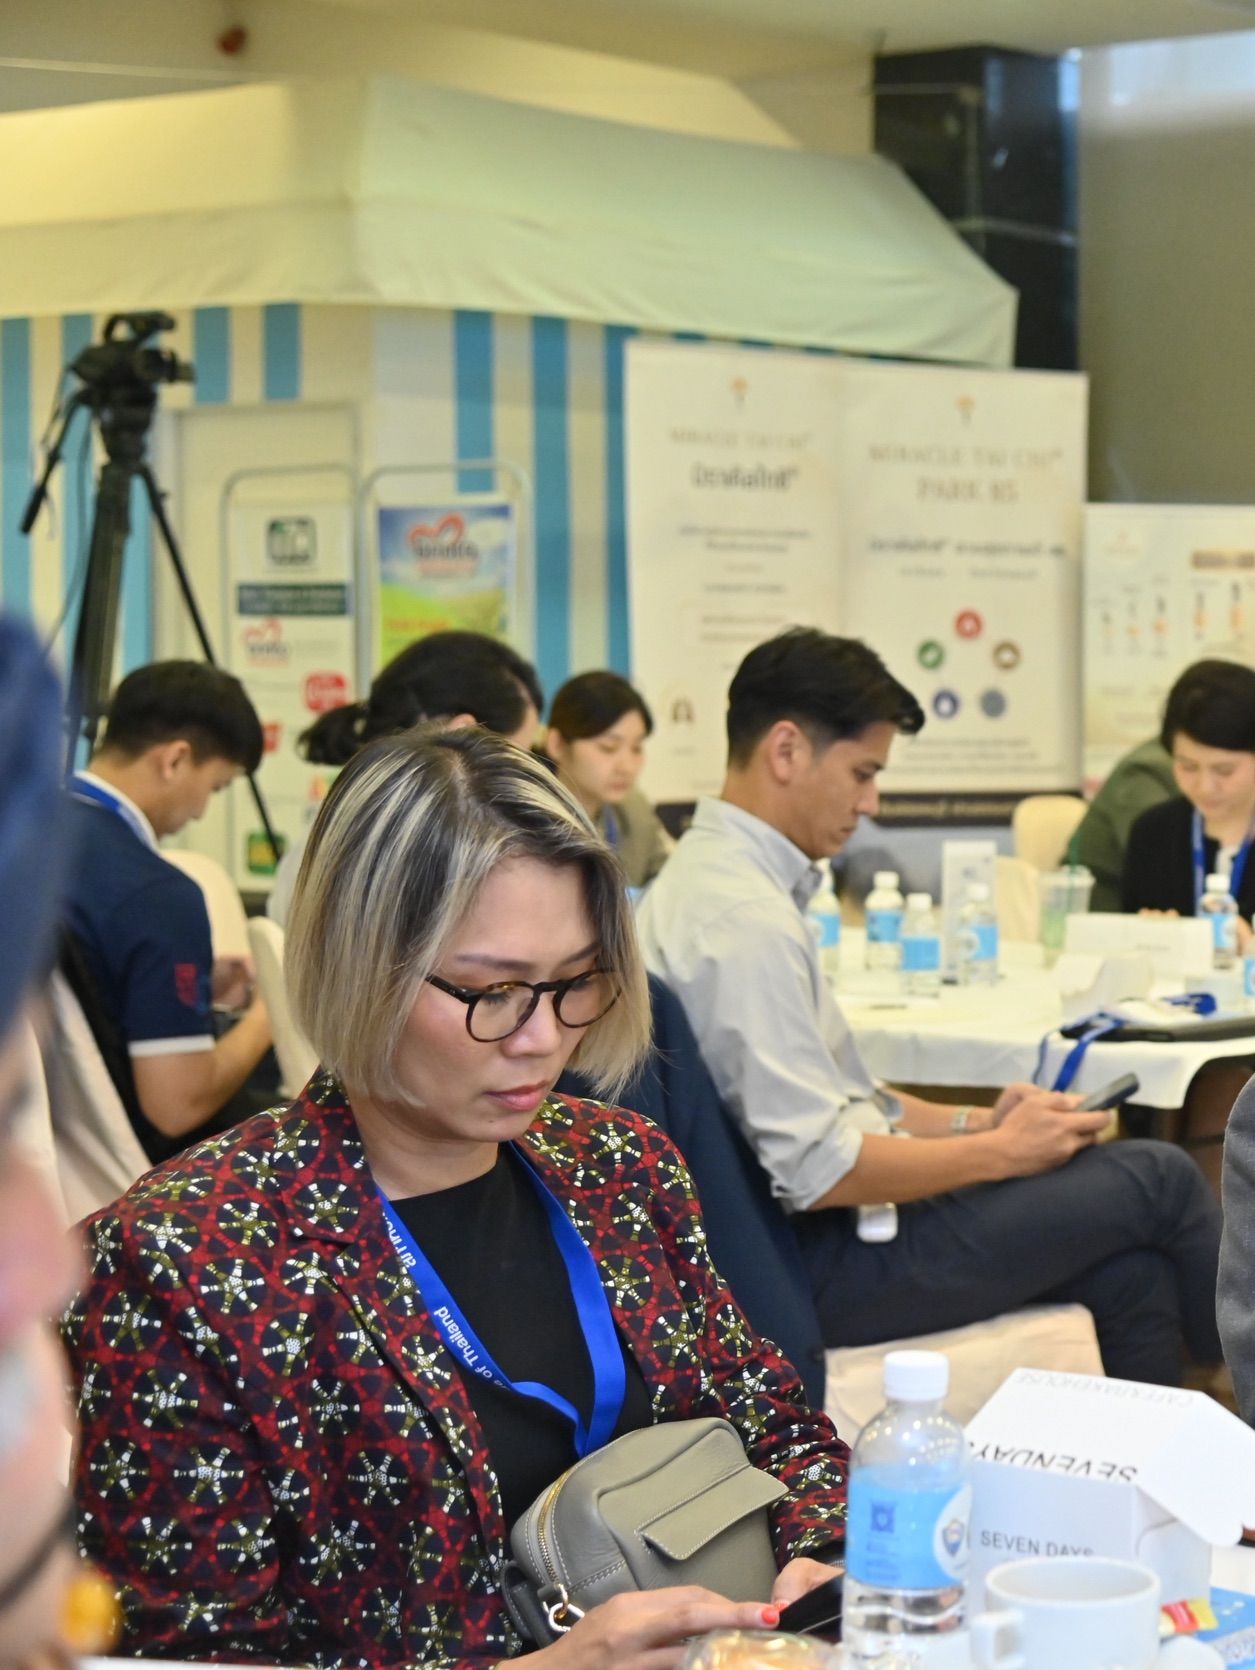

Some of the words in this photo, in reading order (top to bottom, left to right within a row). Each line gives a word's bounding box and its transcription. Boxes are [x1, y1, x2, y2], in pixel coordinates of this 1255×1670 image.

[433, 1306, 479, 1367] Thailand
[474, 1365, 493, 1378] of
[968, 1440, 1139, 1483] SEVENDAY
[980, 1529, 1040, 1556] SEVEN
